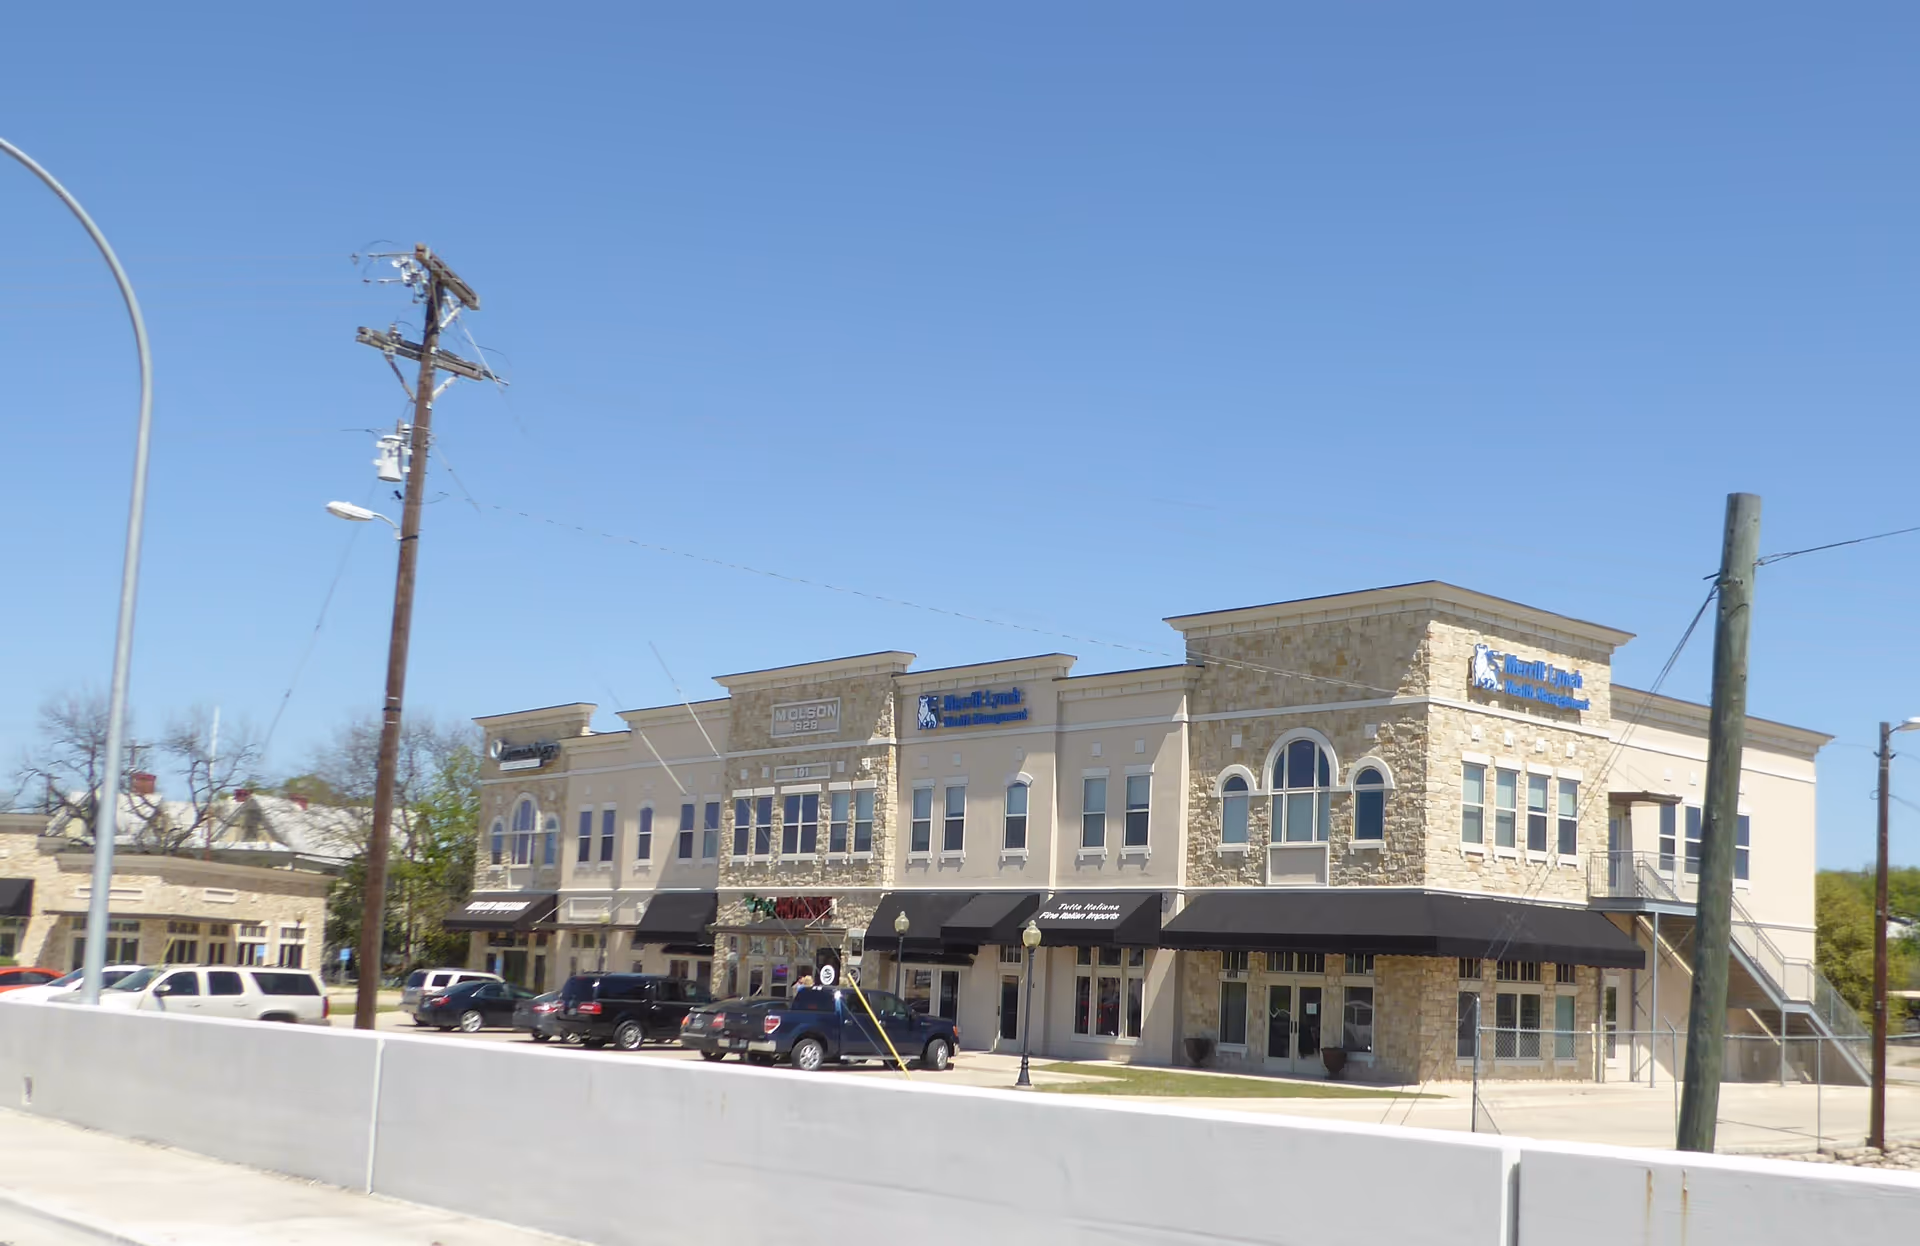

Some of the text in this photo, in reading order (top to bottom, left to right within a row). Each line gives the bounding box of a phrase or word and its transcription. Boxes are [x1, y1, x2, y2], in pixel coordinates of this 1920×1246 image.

[1505, 654, 1583, 689] Merrill Lynch
[986, 687, 1021, 708] Lynch
[1505, 680, 1534, 699] Wealth
[775, 703, 837, 721] MOLSON
[1038, 911, 1120, 921] Fine Italian Imports
